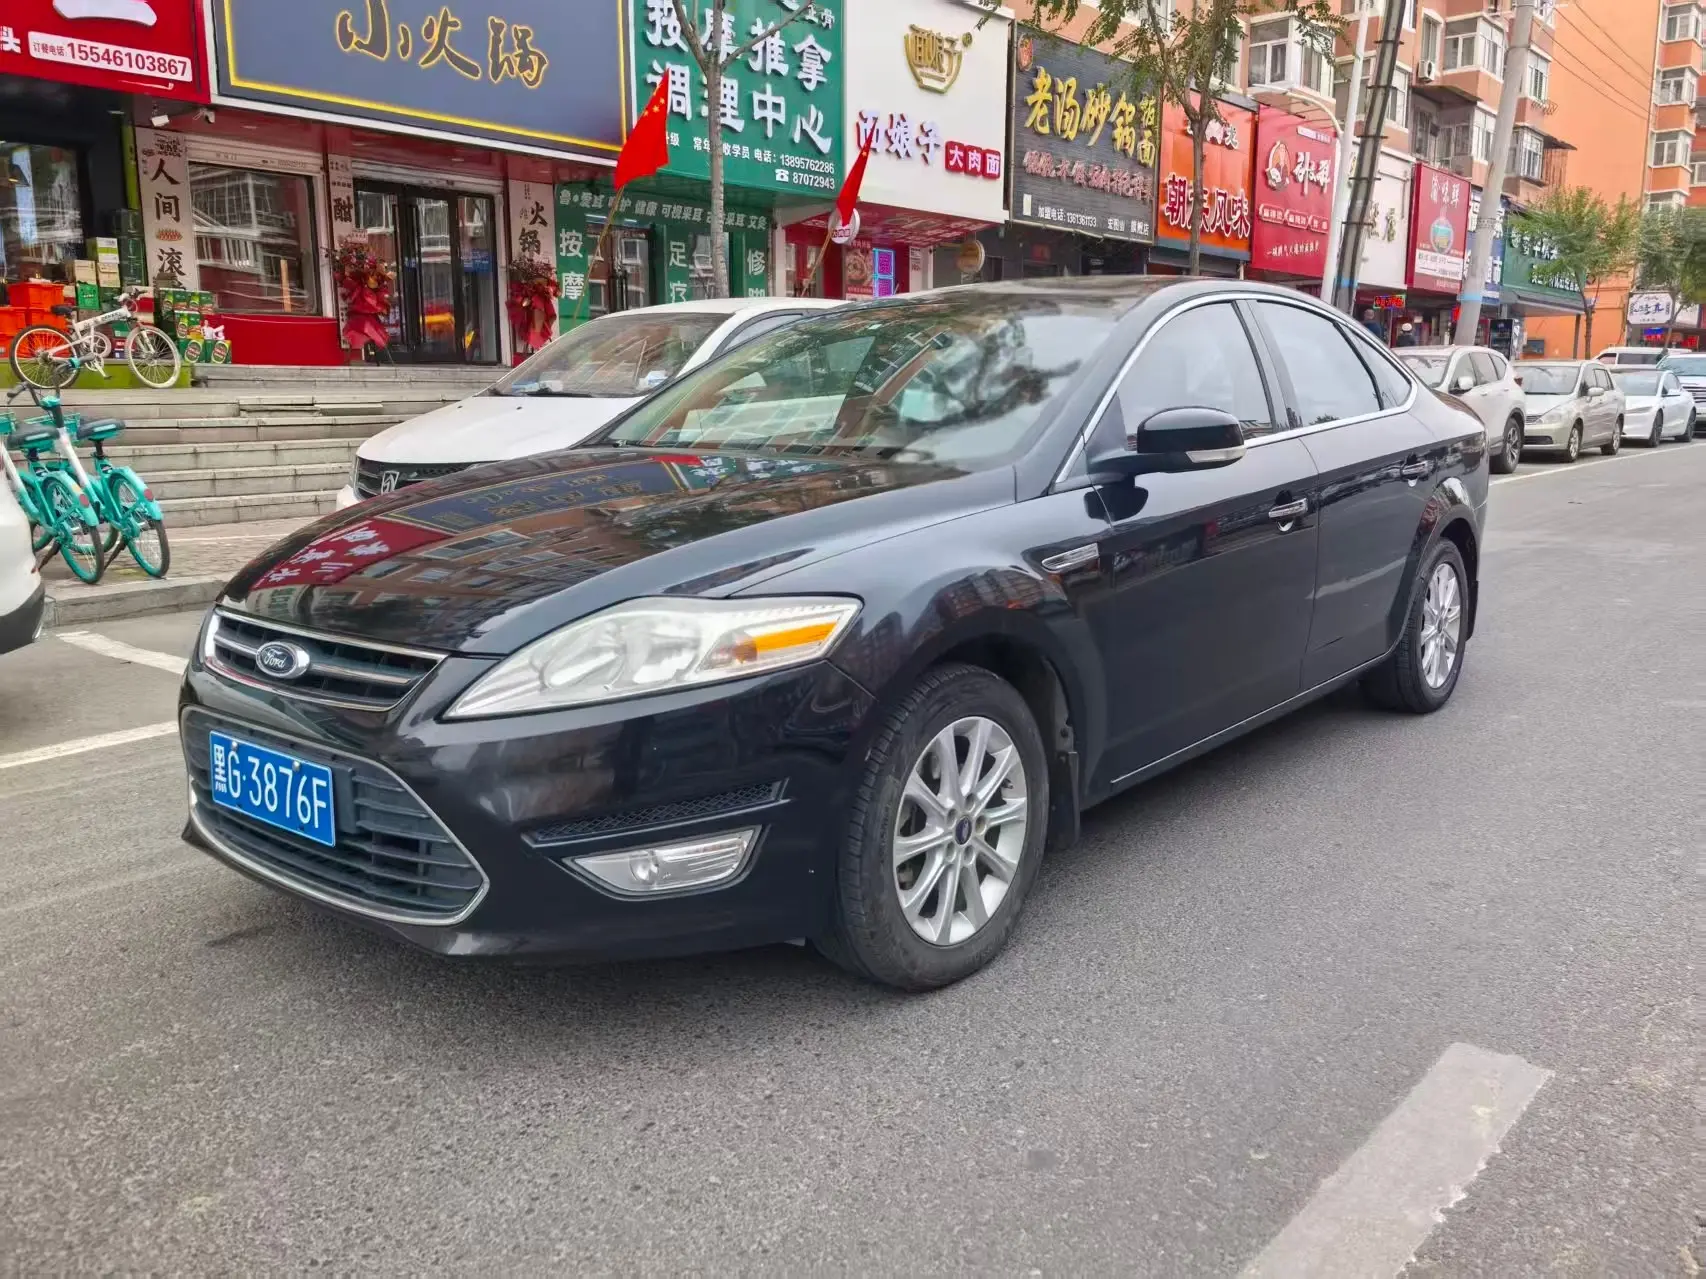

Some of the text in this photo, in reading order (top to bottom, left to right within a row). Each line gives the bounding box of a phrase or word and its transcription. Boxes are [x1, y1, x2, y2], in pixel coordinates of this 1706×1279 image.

[67, 42, 188, 77] 15546103867
[335, 0, 549, 89] 小火锅
[646, 59, 834, 156] 调理中心
[693, 136, 750, 160] 常年收学员
[779, 153, 835, 174] 13895762286
[792, 171, 836, 190] 87072943
[949, 146, 1000, 176] 大肉面
[151, 158, 183, 223] 人间
[518, 200, 548, 256] 火锅
[559, 227, 586, 300] 按摩
[669, 240, 688, 303] 足疗
[261, 647, 288, 670] Ford
